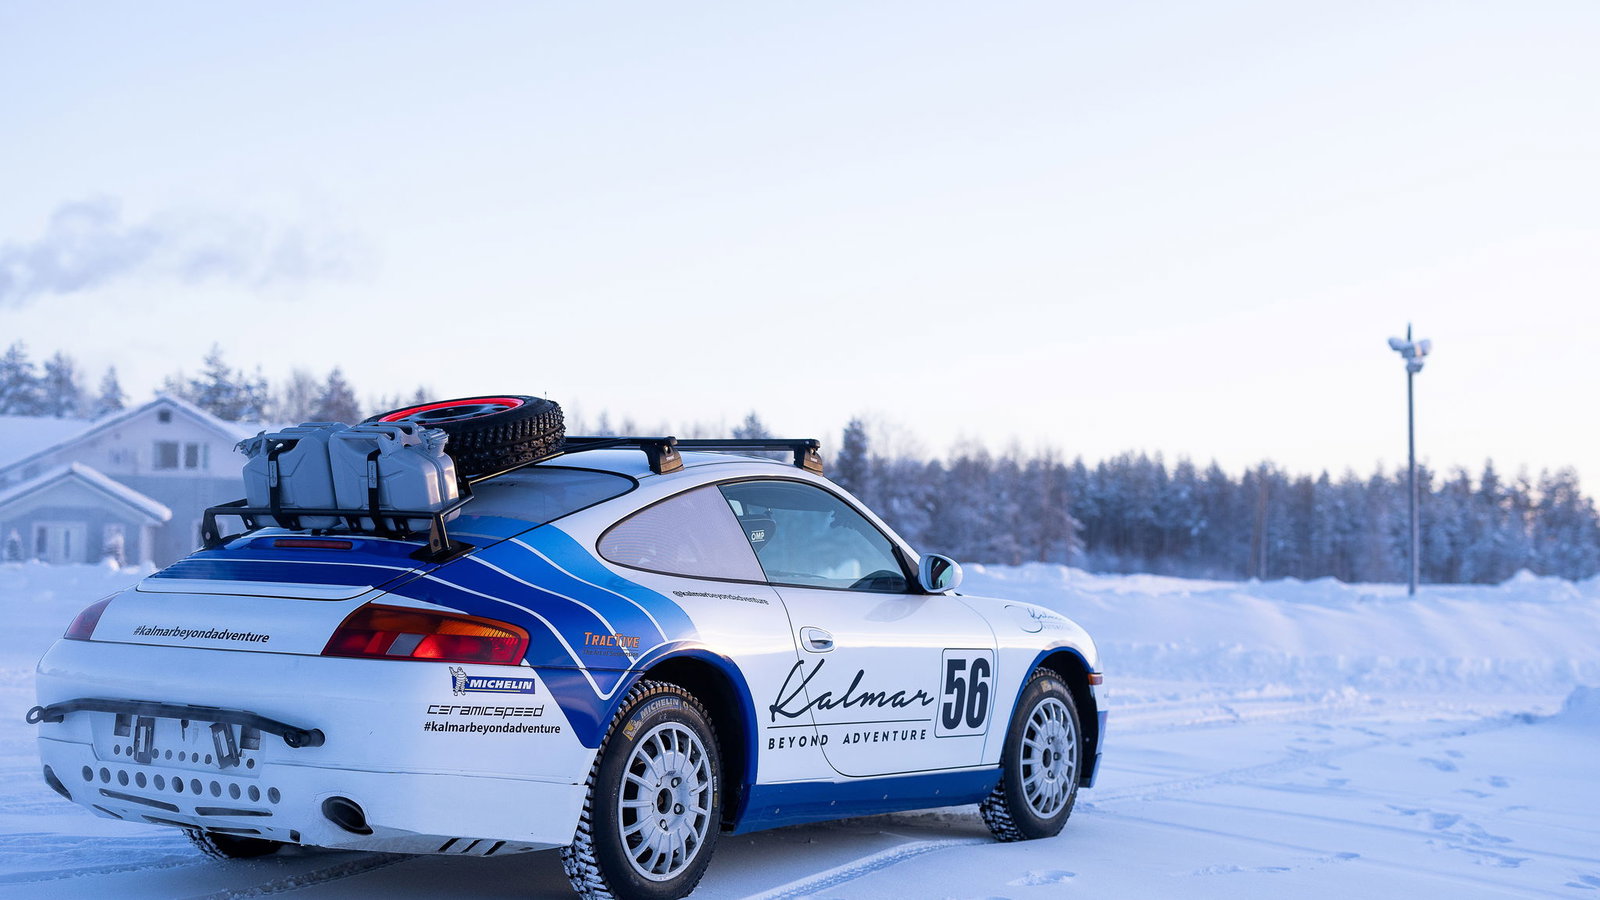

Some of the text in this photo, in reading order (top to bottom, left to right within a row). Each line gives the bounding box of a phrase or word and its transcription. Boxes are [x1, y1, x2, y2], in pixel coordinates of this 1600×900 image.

[751, 532, 765, 541] OMP
[133, 625, 270, 643] #kalmarbeyondadventure
[469, 679, 533, 690] MICHELIN
[769, 658, 934, 722] Kalmar
[942, 658, 991, 730] 56
[640, 699, 679, 719] MICHELIN
[424, 721, 561, 736] #kalmarbeyondadventure
[768, 729, 927, 750] BEYOND ADVENTURE
